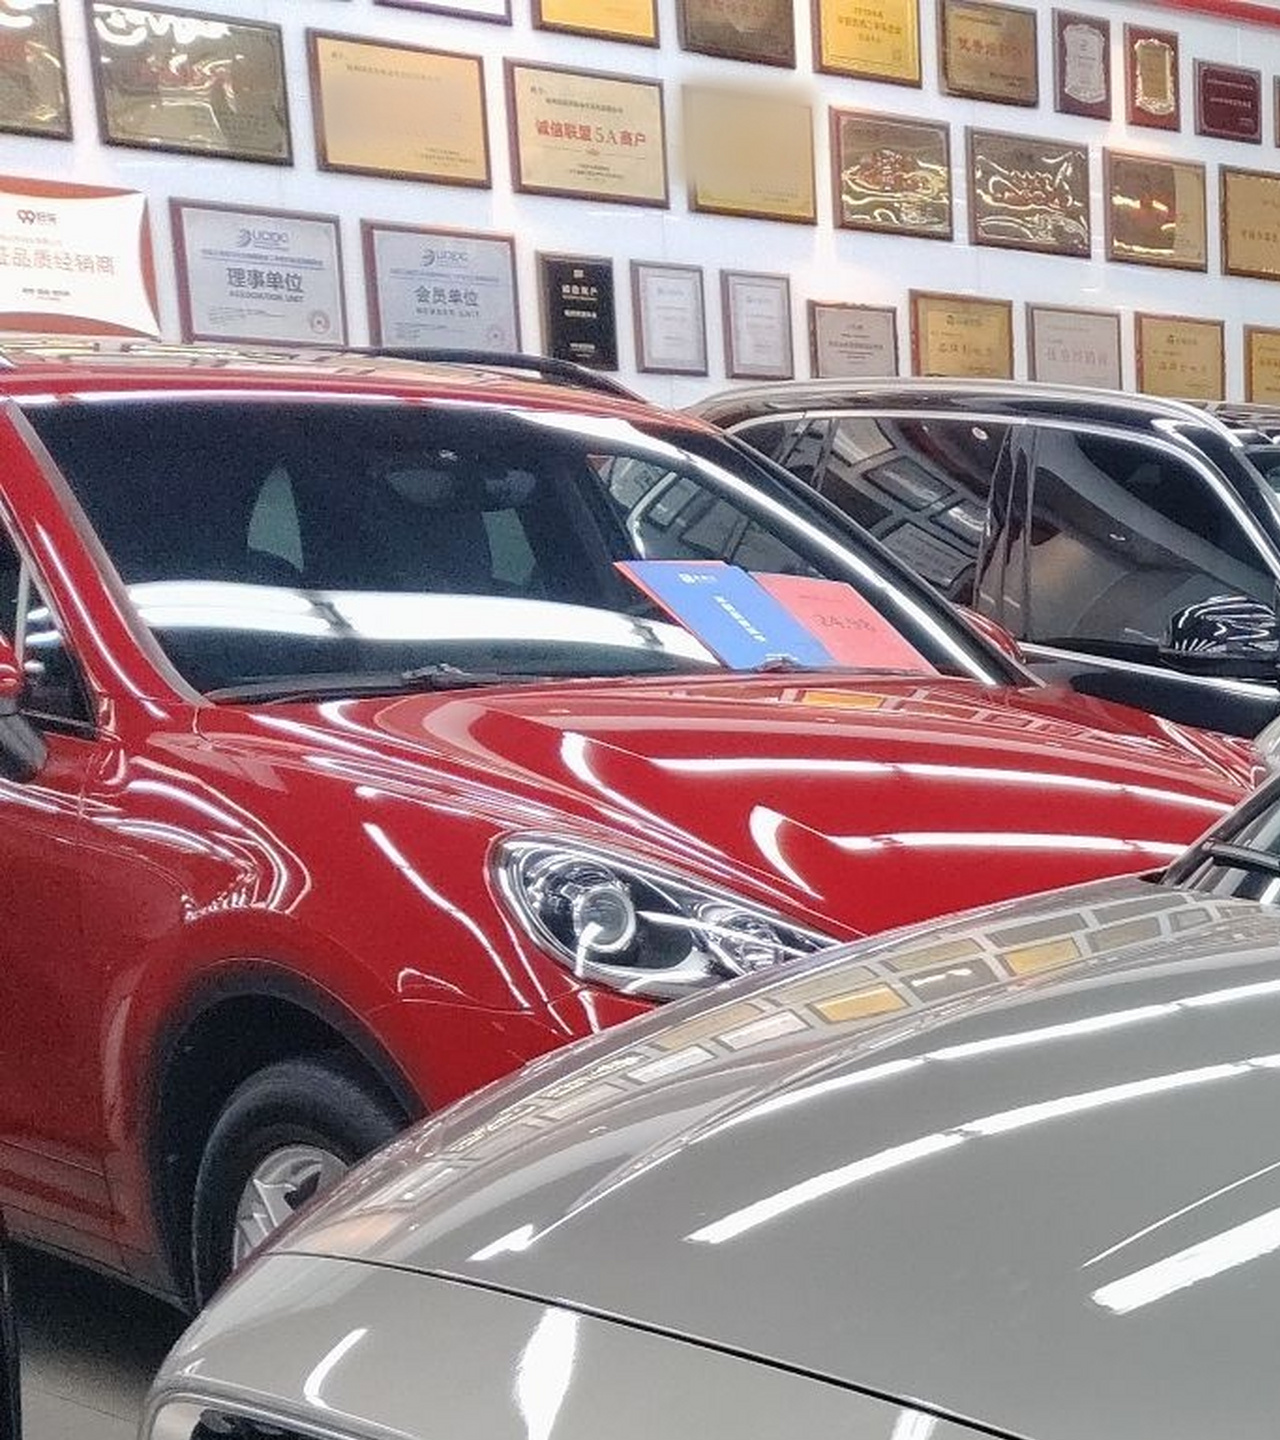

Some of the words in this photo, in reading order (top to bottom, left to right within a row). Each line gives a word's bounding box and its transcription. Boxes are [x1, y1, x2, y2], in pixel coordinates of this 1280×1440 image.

[226, 267, 303, 293] 理事单位
[415, 284, 479, 306] 会员单位
